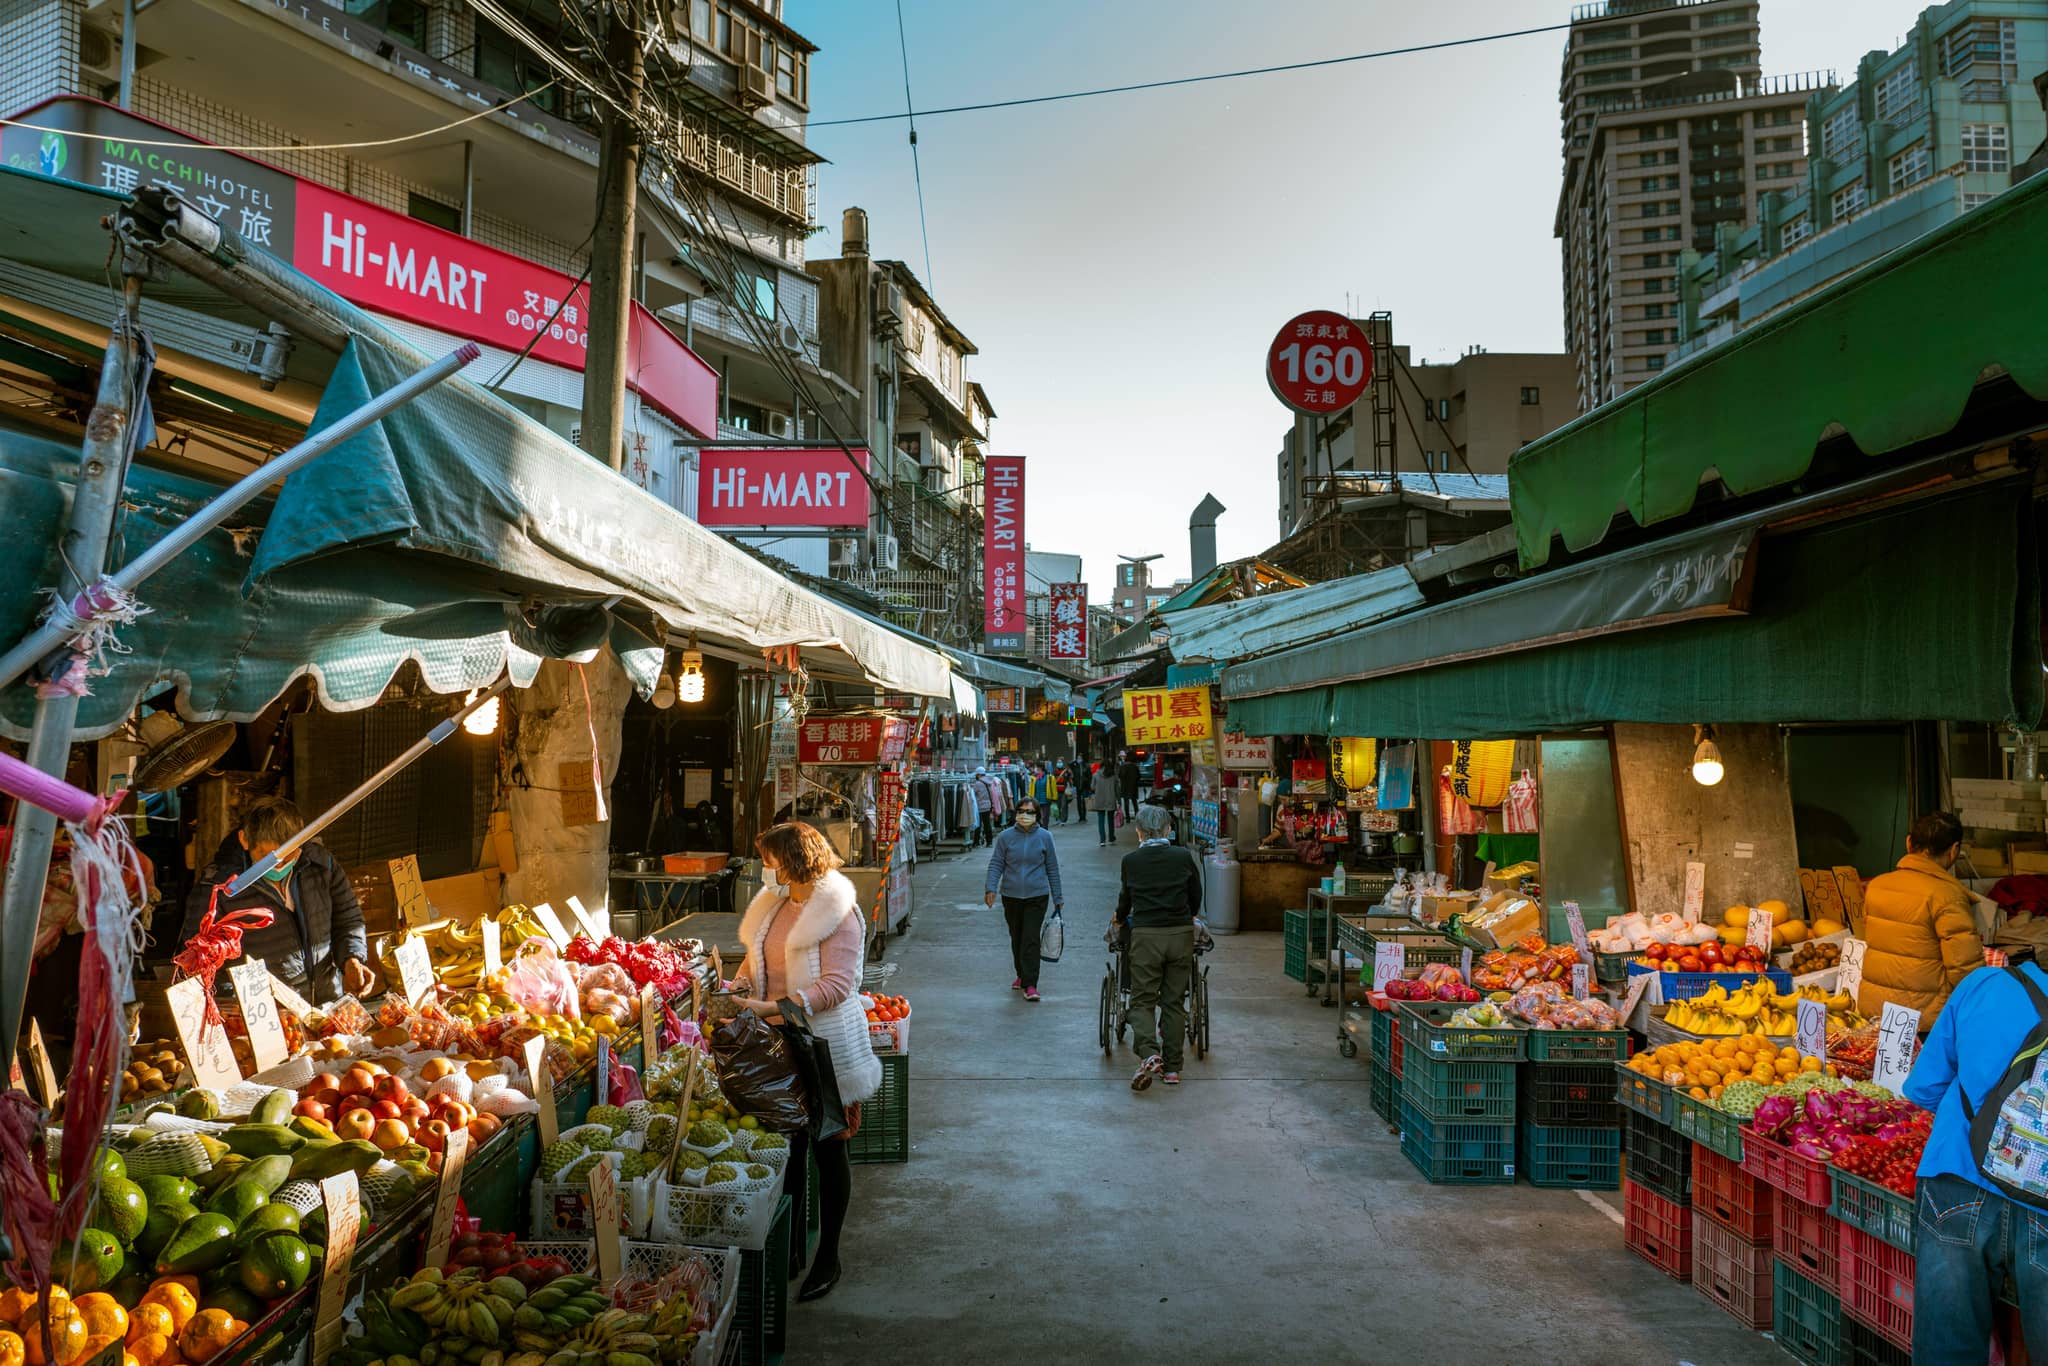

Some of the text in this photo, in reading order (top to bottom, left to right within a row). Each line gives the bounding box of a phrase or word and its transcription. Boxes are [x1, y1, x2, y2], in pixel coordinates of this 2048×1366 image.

[322, 211, 488, 314] Hi-MART
[1279, 343, 1364, 386] 160
[1304, 389, 1337, 404] 元起
[712, 467, 851, 508] Hi-MART
[993, 467, 1019, 552] Hi-MART
[1055, 599, 1084, 656] 銀樓
[805, 722, 872, 742] 香雞排
[1132, 722, 1206, 741] 手工水餃
[821, 746, 840, 760] 70
[1225, 750, 1267, 759] 手工水餃
[1376, 961, 1398, 980] 100
[247, 1002, 267, 1026] 50
[1880, 1007, 1909, 1044] 49
